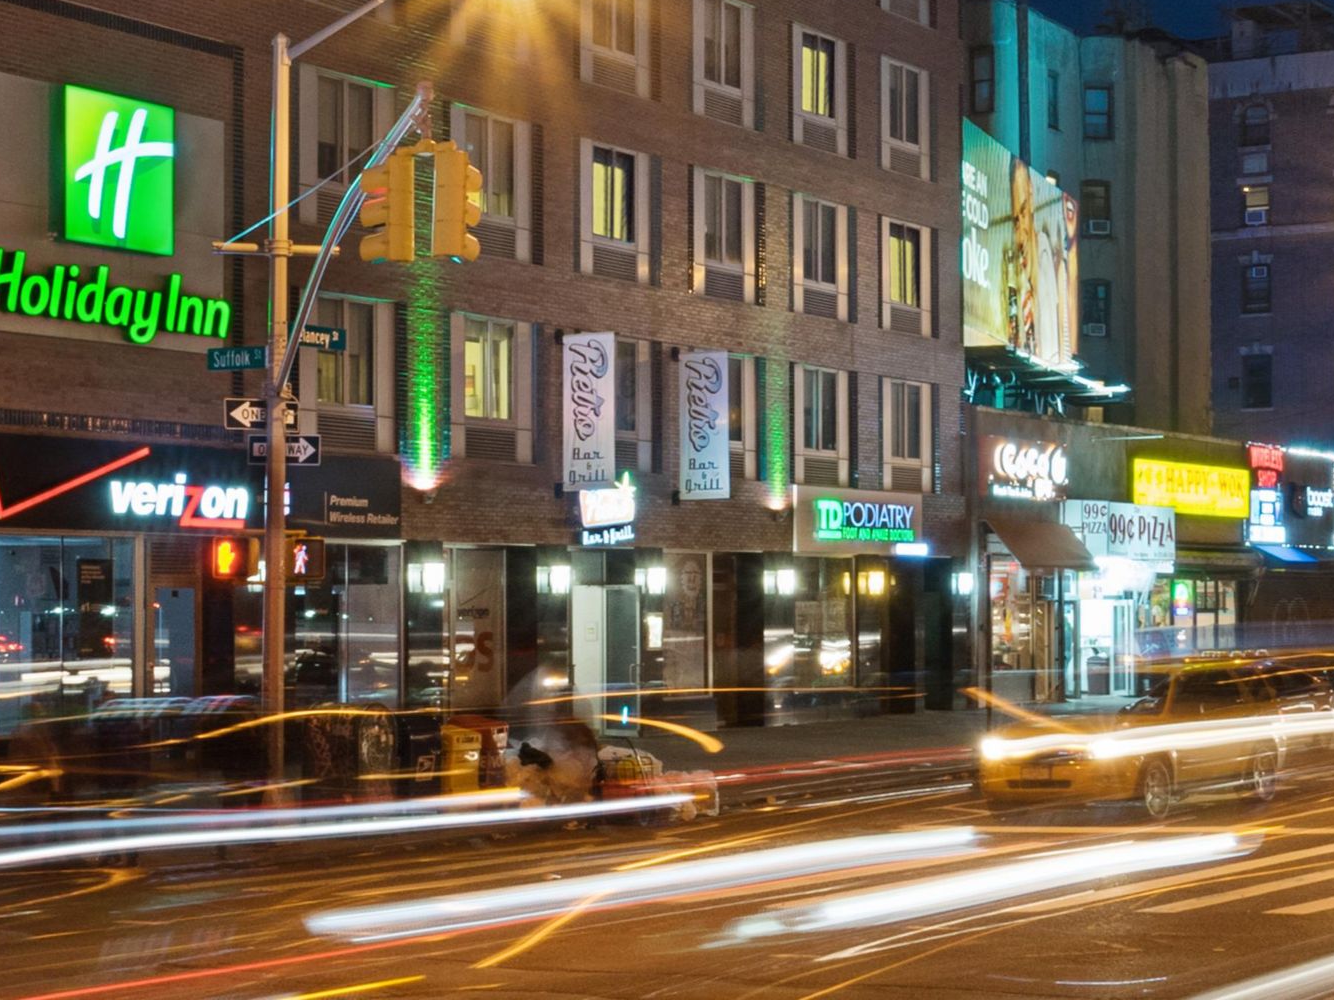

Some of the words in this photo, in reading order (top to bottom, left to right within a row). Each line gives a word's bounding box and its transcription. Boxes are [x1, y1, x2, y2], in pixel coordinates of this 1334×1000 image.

[967, 194, 990, 231] COLD
[166, 273, 231, 339] Inn
[213, 351, 251, 368] Suffolk
[569, 339, 609, 442] Retro
[685, 357, 723, 453] Retro
[572, 448, 603, 460] Bar
[689, 458, 718, 470] Bar
[1166, 467, 1210, 494] HAPPY
[110, 473, 249, 528] verizon
[329, 495, 368, 508] Premium
[1307, 486, 1334, 508] boost
[329, 511, 366, 524] Wireless
[367, 512, 400, 525] Retailer
[817, 500, 842, 530] TD
[843, 502, 913, 529] PODIATRY
[1083, 521, 1108, 534] PIZZA
[1139, 516, 1173, 547] PIZZA
